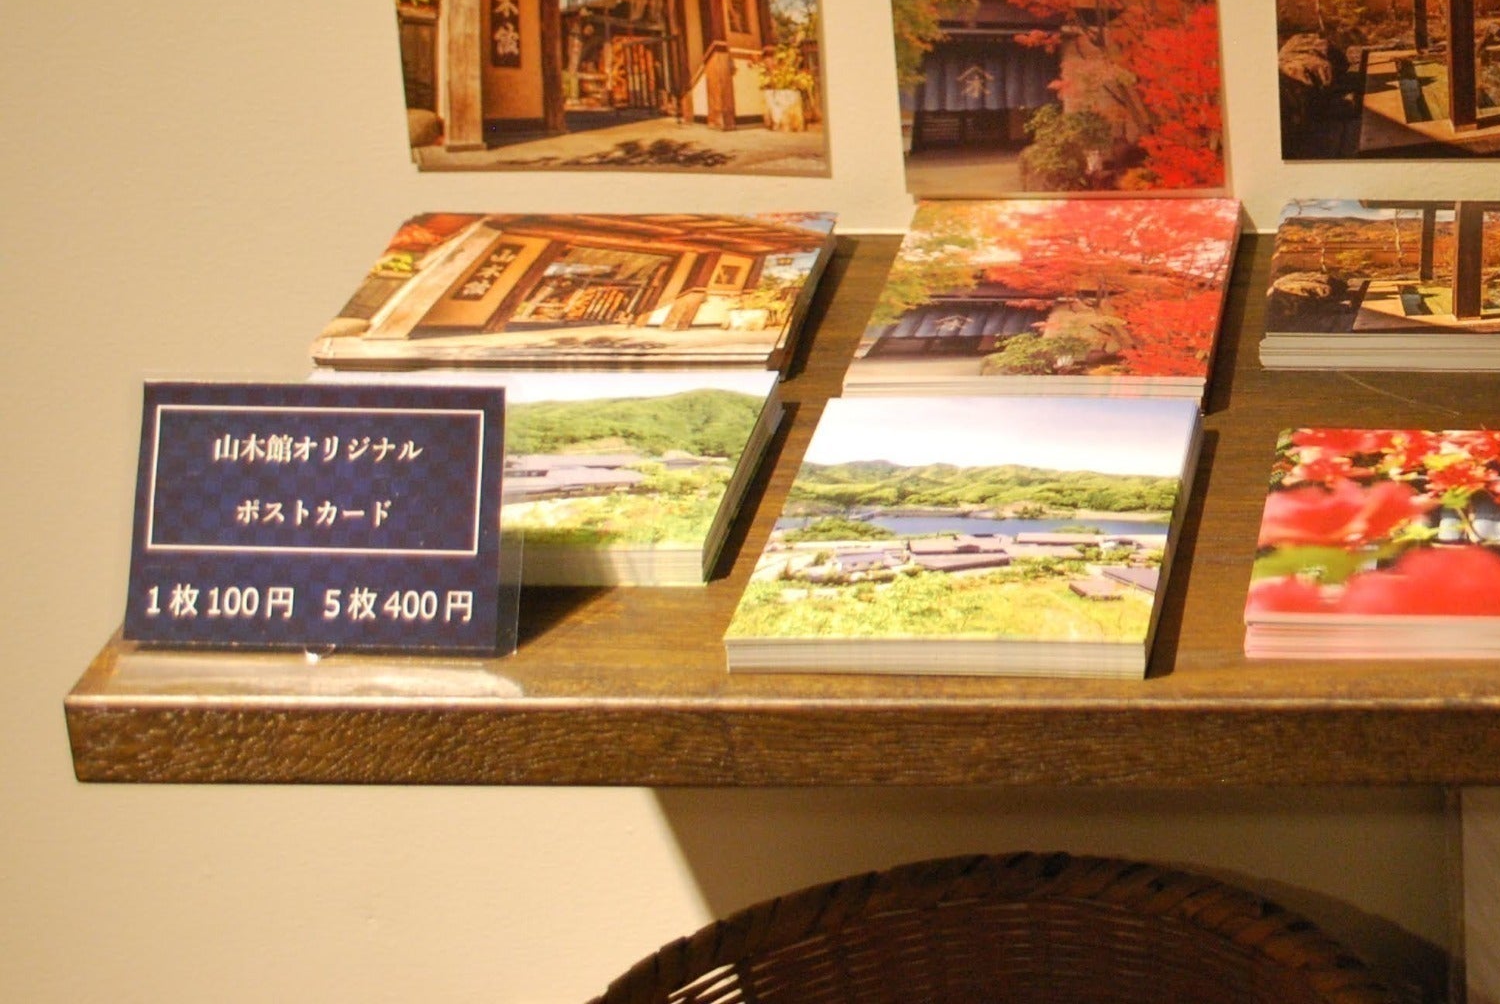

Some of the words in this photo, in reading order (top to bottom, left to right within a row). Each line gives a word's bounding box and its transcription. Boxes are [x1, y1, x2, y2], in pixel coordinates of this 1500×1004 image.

[213, 433, 424, 463] 山木館オリジナル
[236, 499, 393, 528] ポストカード
[145, 583, 296, 620] 1枚100円
[323, 587, 475, 624] 5枚400円
